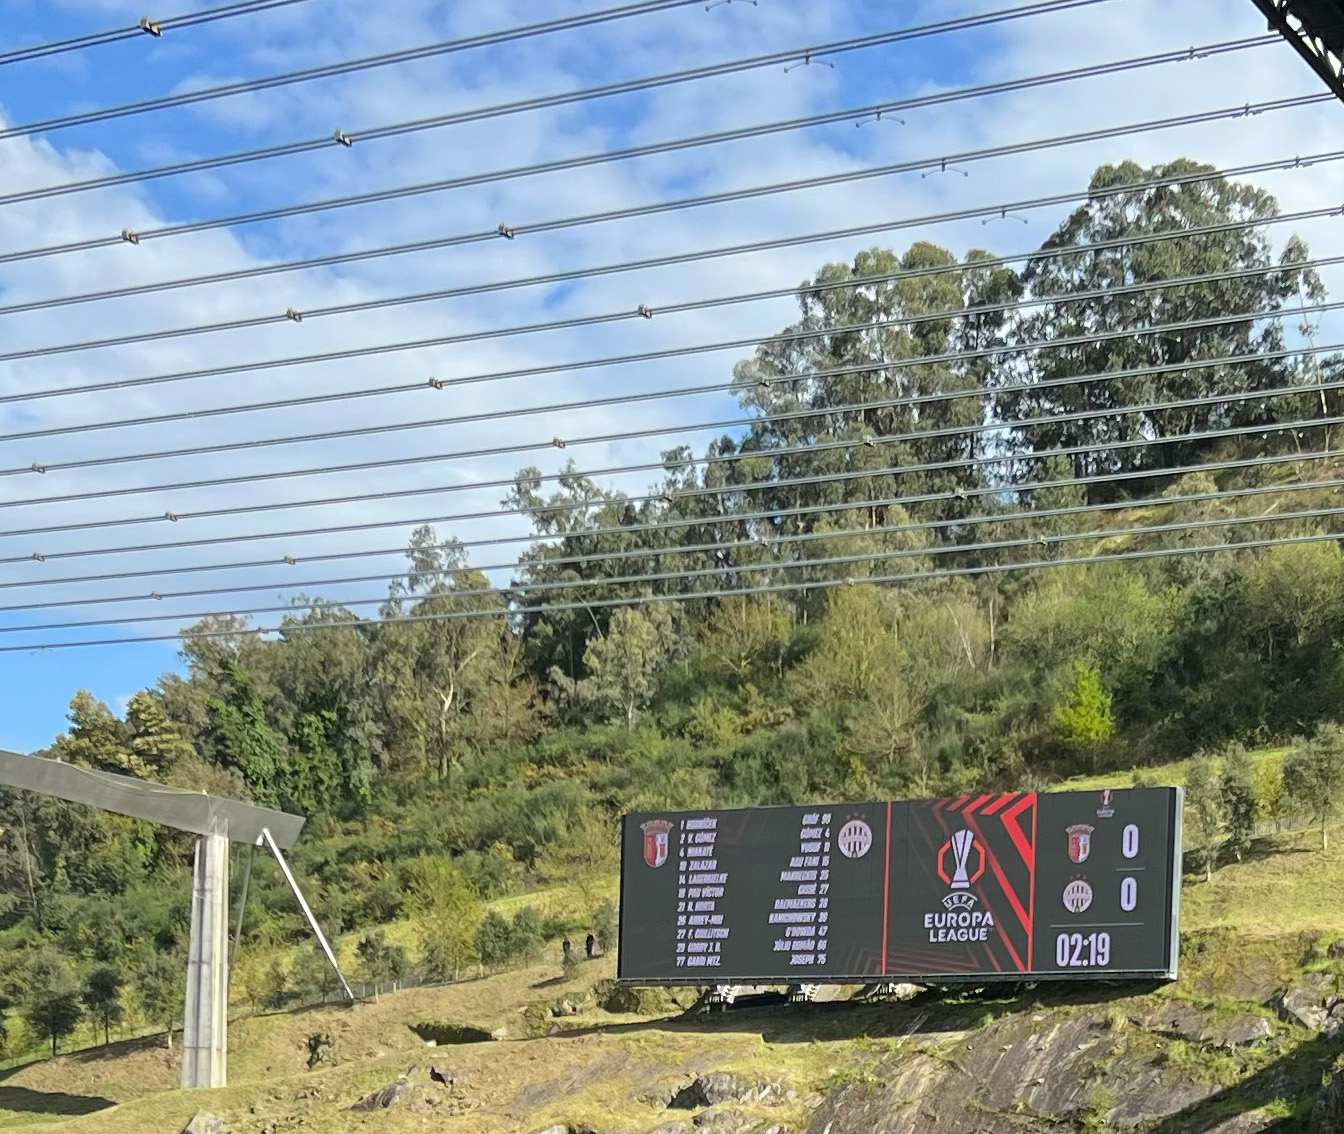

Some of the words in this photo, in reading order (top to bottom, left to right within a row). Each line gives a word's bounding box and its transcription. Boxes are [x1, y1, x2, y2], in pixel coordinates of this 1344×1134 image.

[1122, 824, 1139, 858] 0
[943, 895, 975, 909] UEFA
[1120, 877, 1137, 911] 0
[924, 911, 994, 928] EUROPA
[929, 928, 988, 942] LEAGUE
[1056, 932, 1110, 967] 02:19
